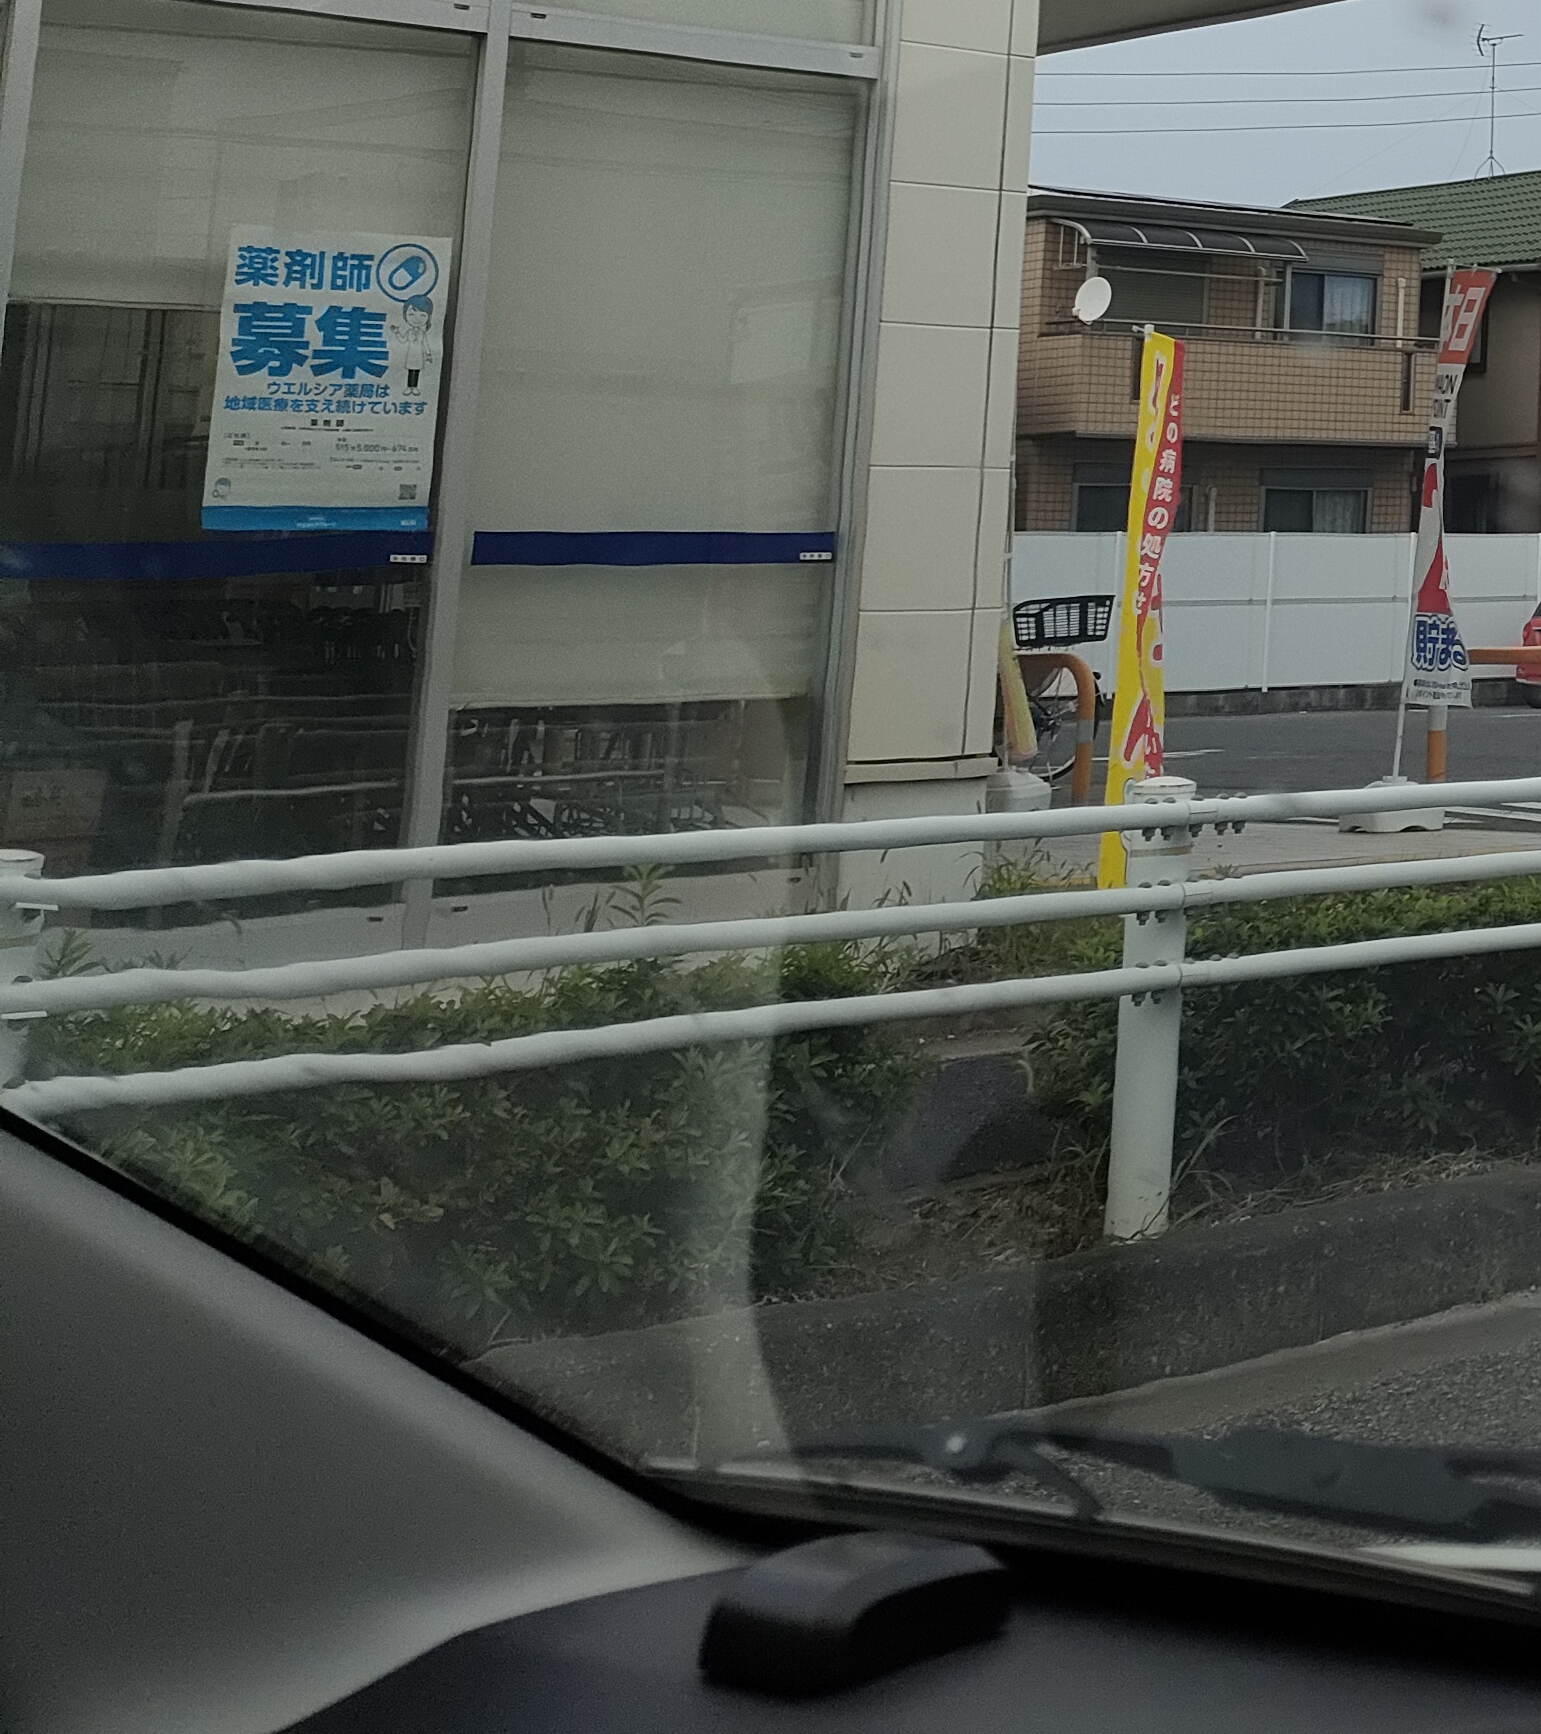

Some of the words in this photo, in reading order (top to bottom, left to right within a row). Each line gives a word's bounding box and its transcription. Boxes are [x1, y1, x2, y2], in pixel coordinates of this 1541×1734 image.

[235, 245, 375, 293] 薬剤師
[229, 301, 390, 380] 募集
[223, 395, 428, 416] 地域医療を支え続けています
[266, 381, 390, 398] ウエルシア薬局は
